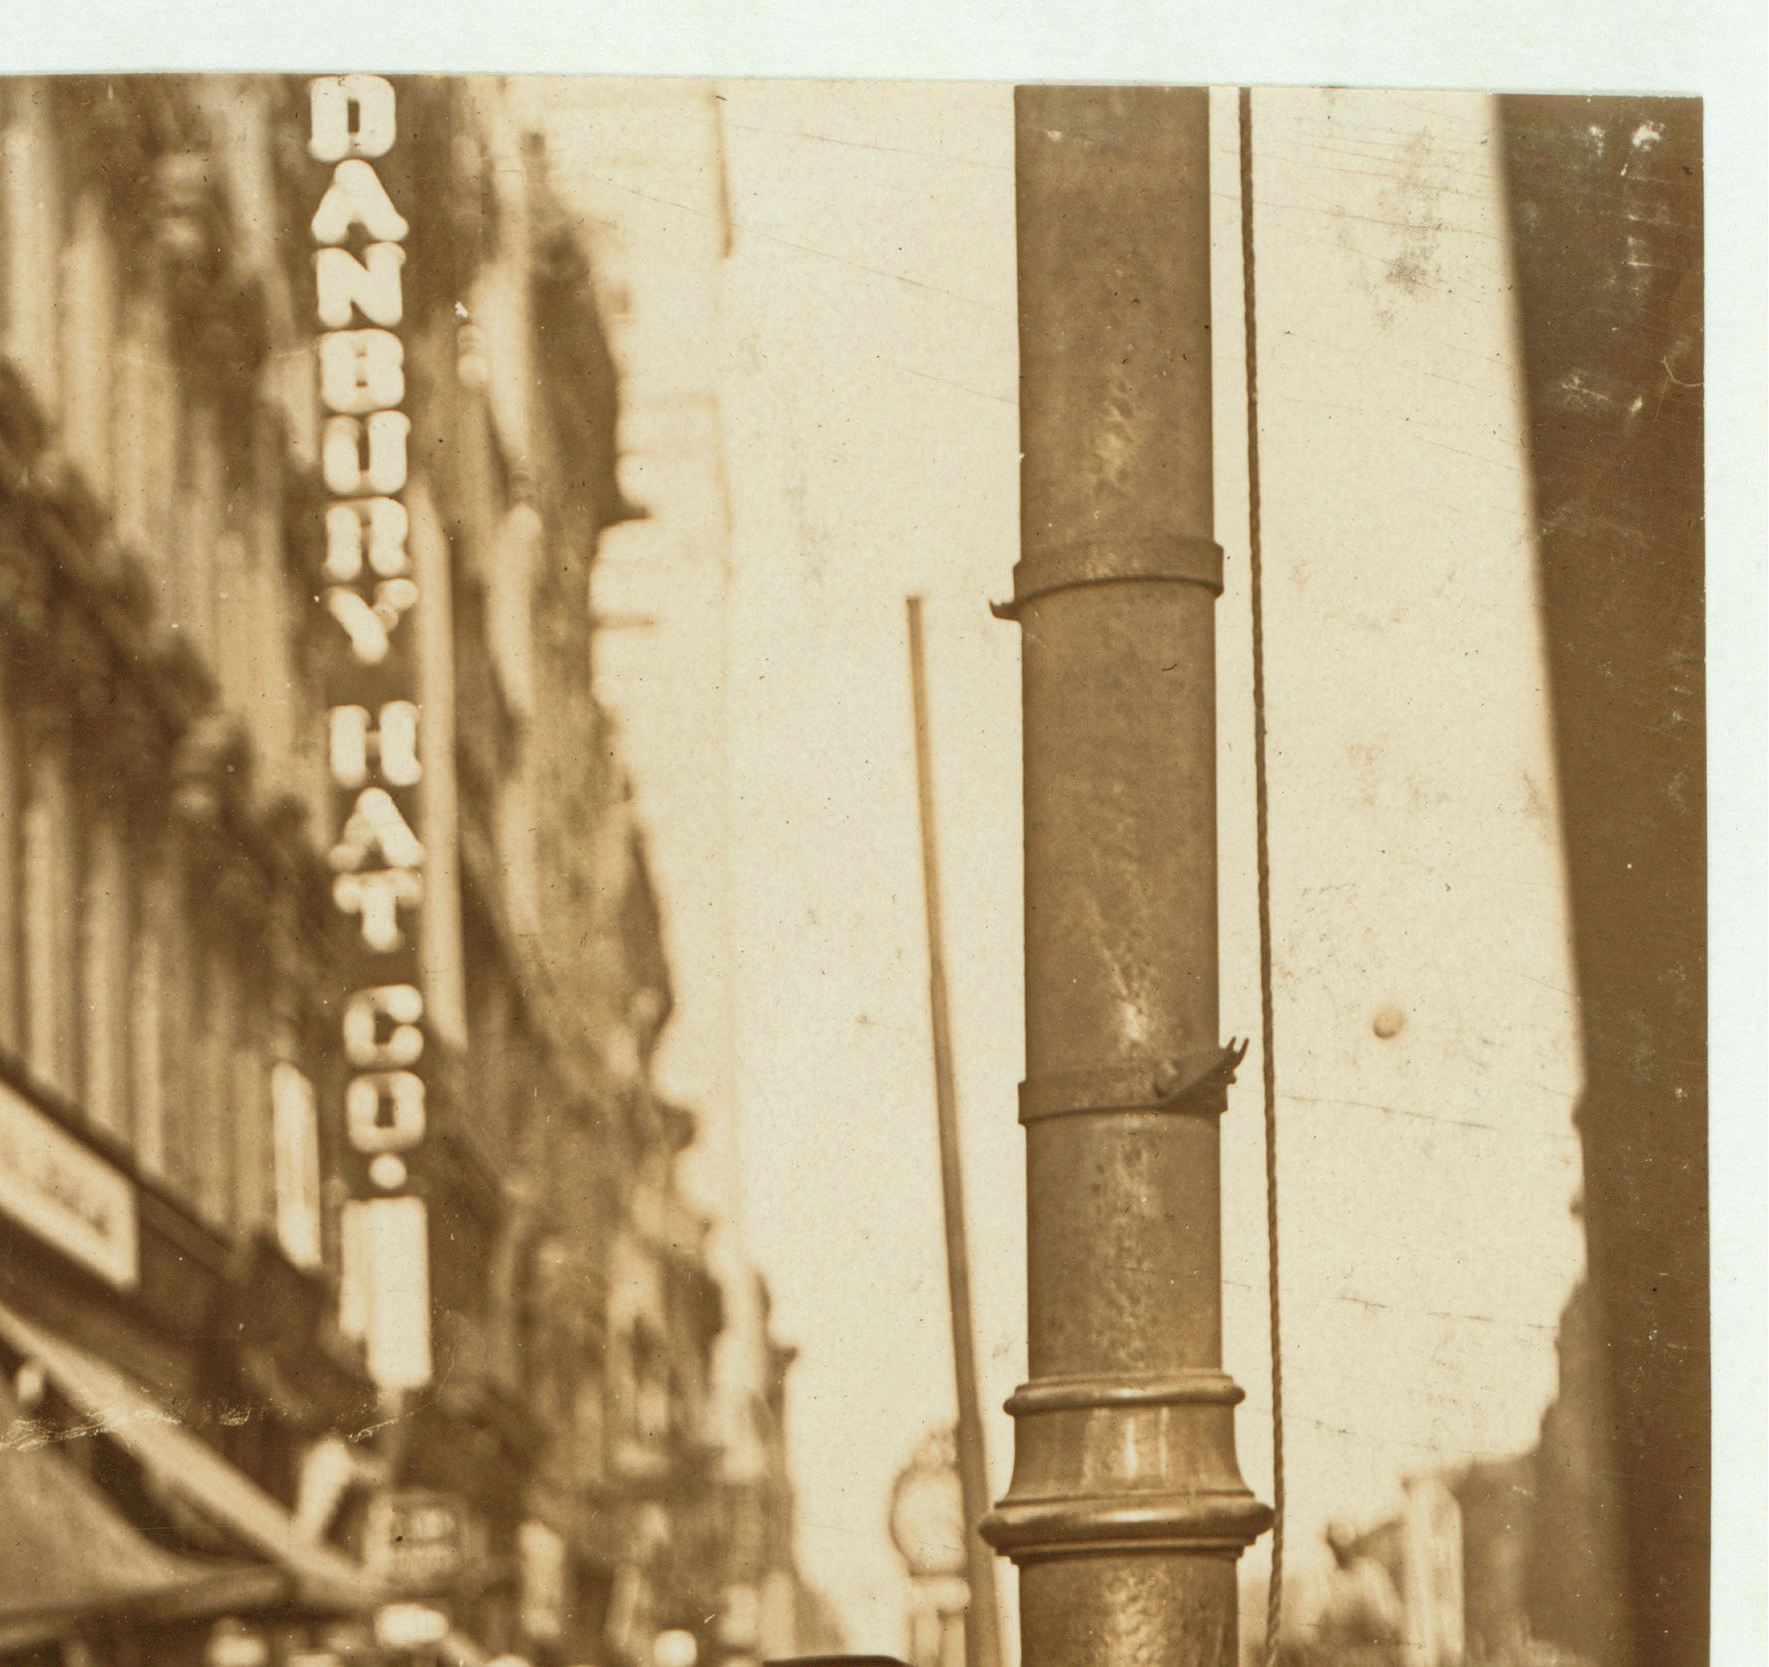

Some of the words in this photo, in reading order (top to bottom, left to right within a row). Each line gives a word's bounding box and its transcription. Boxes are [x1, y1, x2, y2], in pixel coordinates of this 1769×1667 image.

[309, 75, 419, 664] DANBURY
[331, 700, 425, 953] HAT
[343, 983, 427, 1190] CO.
